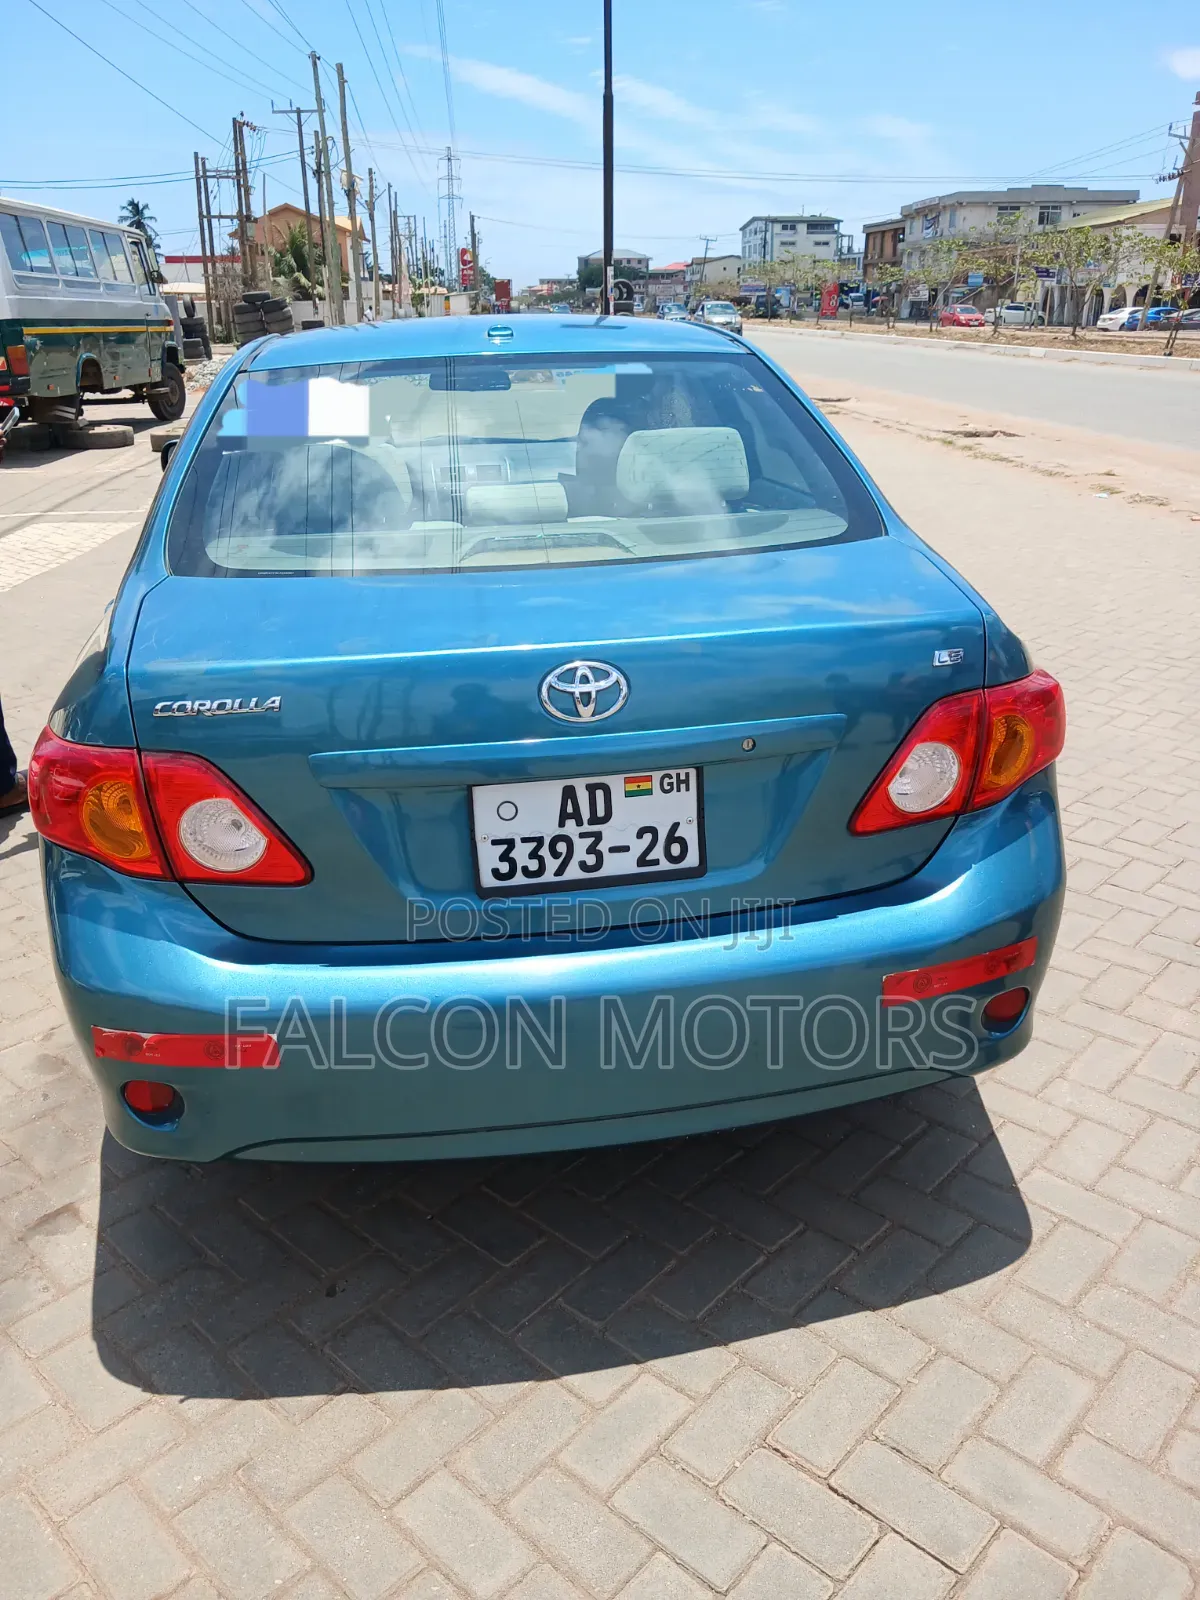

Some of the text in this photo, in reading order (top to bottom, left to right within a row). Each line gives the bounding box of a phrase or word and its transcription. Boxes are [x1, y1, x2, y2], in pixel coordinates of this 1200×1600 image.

[153, 696, 282, 718] COROLLA
[659, 772, 690, 794] GH
[558, 782, 613, 828] AD
[490, 822, 689, 881] 3393-26
